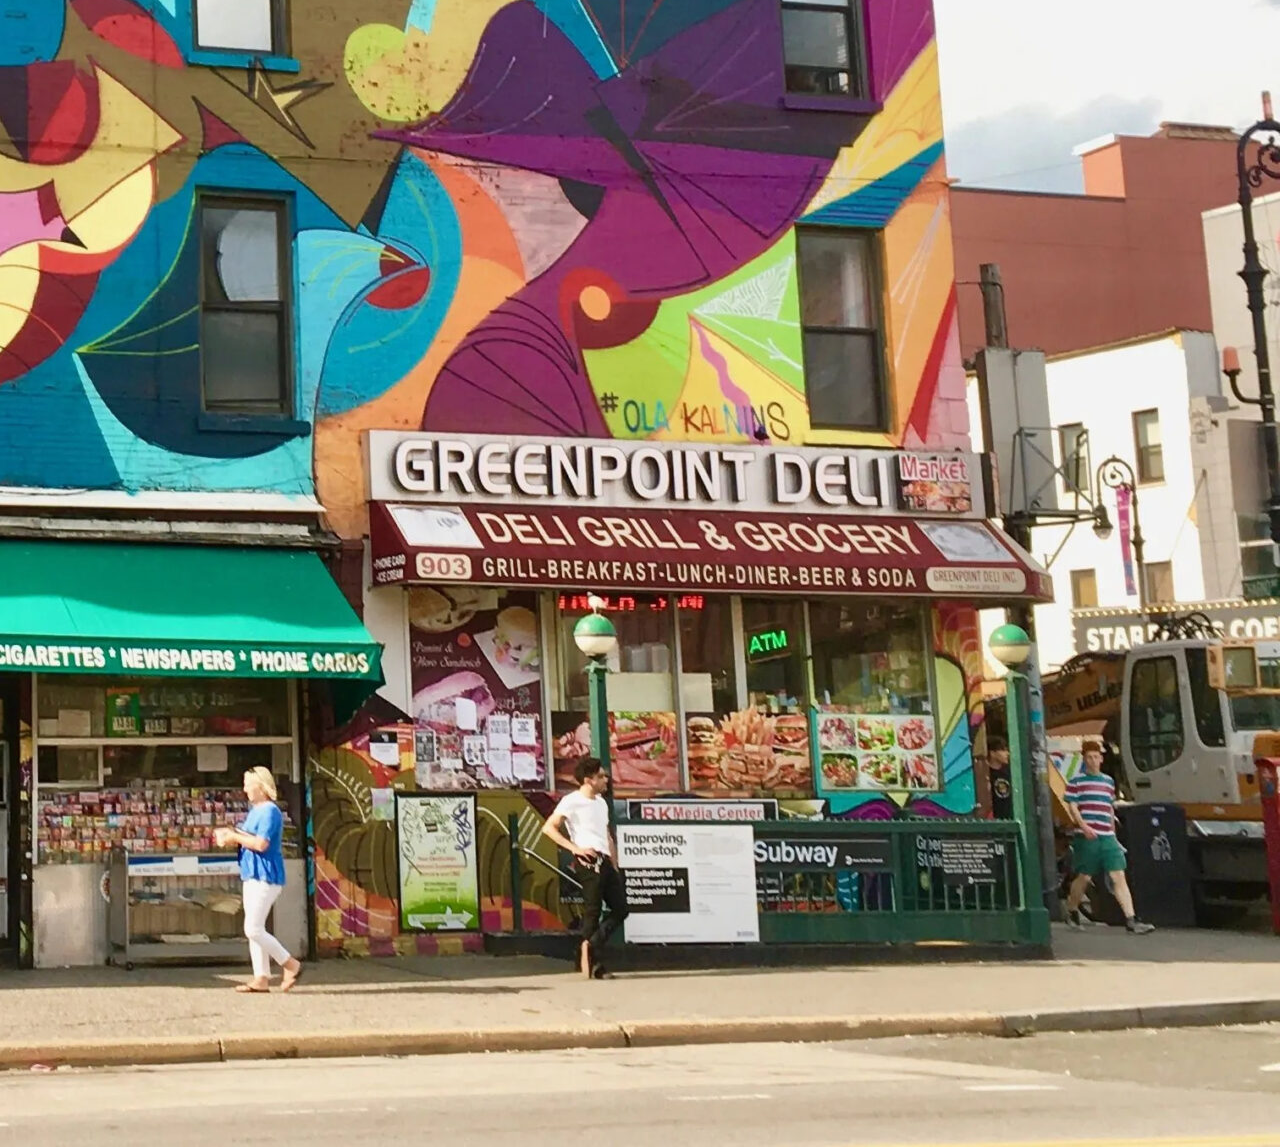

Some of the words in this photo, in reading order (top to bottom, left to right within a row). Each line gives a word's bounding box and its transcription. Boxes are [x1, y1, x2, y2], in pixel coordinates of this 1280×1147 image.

[681, 401, 791, 441] KALNINS
[395, 439, 755, 503] GREENPOINT
[773, 453, 890, 507] DELI
[900, 454, 968, 480] Market
[477, 512, 576, 547] DELI
[577, 516, 701, 550] GRILL
[698, 519, 736, 551] &
[734, 520, 921, 555] GROCERY
[421, 556, 467, 576] 903
[851, 569, 863, 587] &
[867, 568, 917, 588] SODA
[933, 570, 981, 582] GREENPOINT
[983, 571, 1001, 582] DELI
[750, 630, 788, 654] ATM
[121, 647, 236, 672] NEWSPAPERS
[251, 650, 309, 672] PHONE
[311, 652, 370, 674] CARDS
[673, 806, 712, 820] Media
[717, 806, 763, 820] Center
[624, 832, 687, 846] Improving,
[624, 845, 683, 858] non-stop.
[753, 840, 838, 867] Subway
